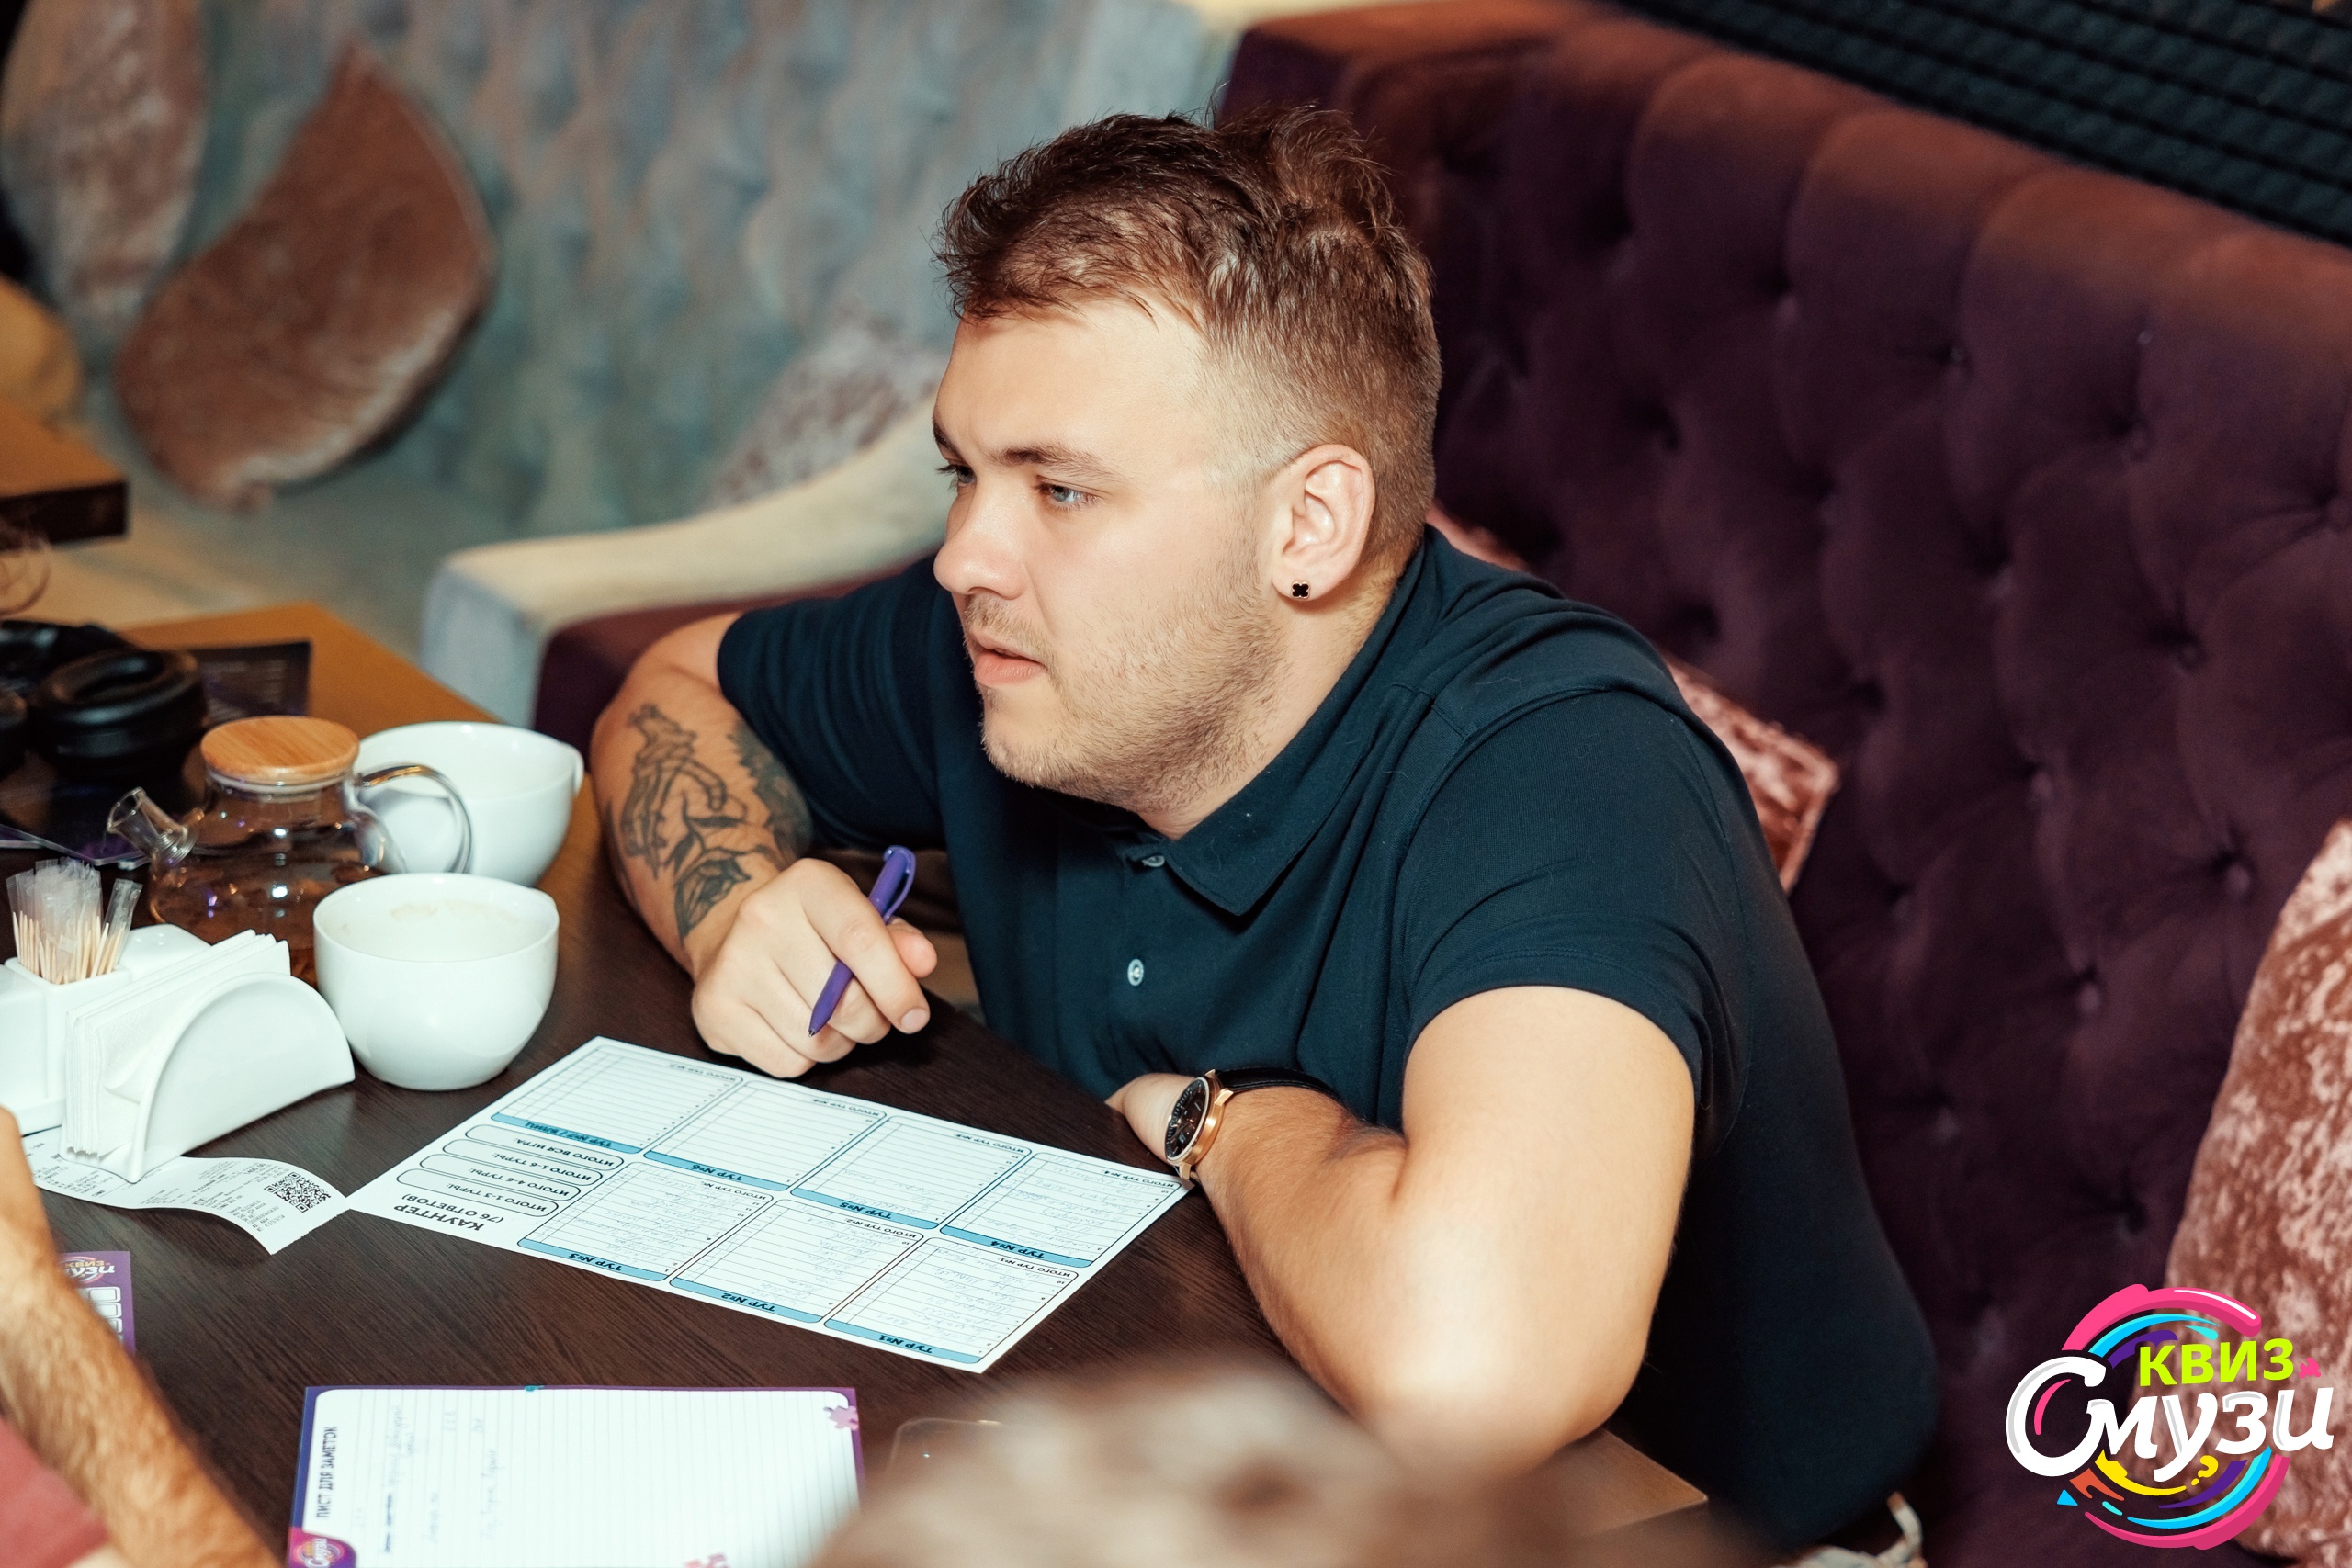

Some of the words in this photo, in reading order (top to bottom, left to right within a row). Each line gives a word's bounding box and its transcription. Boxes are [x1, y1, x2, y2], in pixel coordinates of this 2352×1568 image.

[547, 1147, 571, 1156] ВСЯ
[492, 1154, 526, 1165] ТУРЫ:
[572, 1154, 614, 1167] ИТОГО
[468, 1168, 503, 1180] ТУРЫ:
[549, 1168, 592, 1180] ИТОГО
[691, 1165, 716, 1174] №6
[717, 1172, 741, 1181] ТУР
[1142, 1179, 1174, 1188] ИТОГО
[446, 1184, 481, 1195] ТУРЫ:
[527, 1183, 569, 1196] ИТОГО
[734, 1190, 766, 1200] ИТОГО
[401, 1194, 478, 1216] ОТВЕТОВ)
[504, 1199, 547, 1212] ИТОГО
[839, 1202, 865, 1212] №5
[394, 1205, 484, 1231] КАУНТЕР
[479, 1213, 504, 1223] (76
[865, 1210, 891, 1219] ТУР
[884, 1229, 916, 1238] ИТОГО
[990, 1241, 1017, 1250] №4
[569, 1253, 594, 1262] №3
[1018, 1249, 1044, 1258] ТУР
[595, 1261, 622, 1271] ТУР
[1037, 1268, 1070, 1277] ИТОГО
[721, 1292, 748, 1303] №2
[748, 1302, 775, 1312] ТУР
[879, 1335, 904, 1345] №1
[905, 1343, 932, 1353] ТУР
[321, 1427, 338, 1469] ЗАМЕТОК
[318, 1472, 335, 1491] ДЛЯ
[316, 1494, 332, 1518] ЛИСТ
